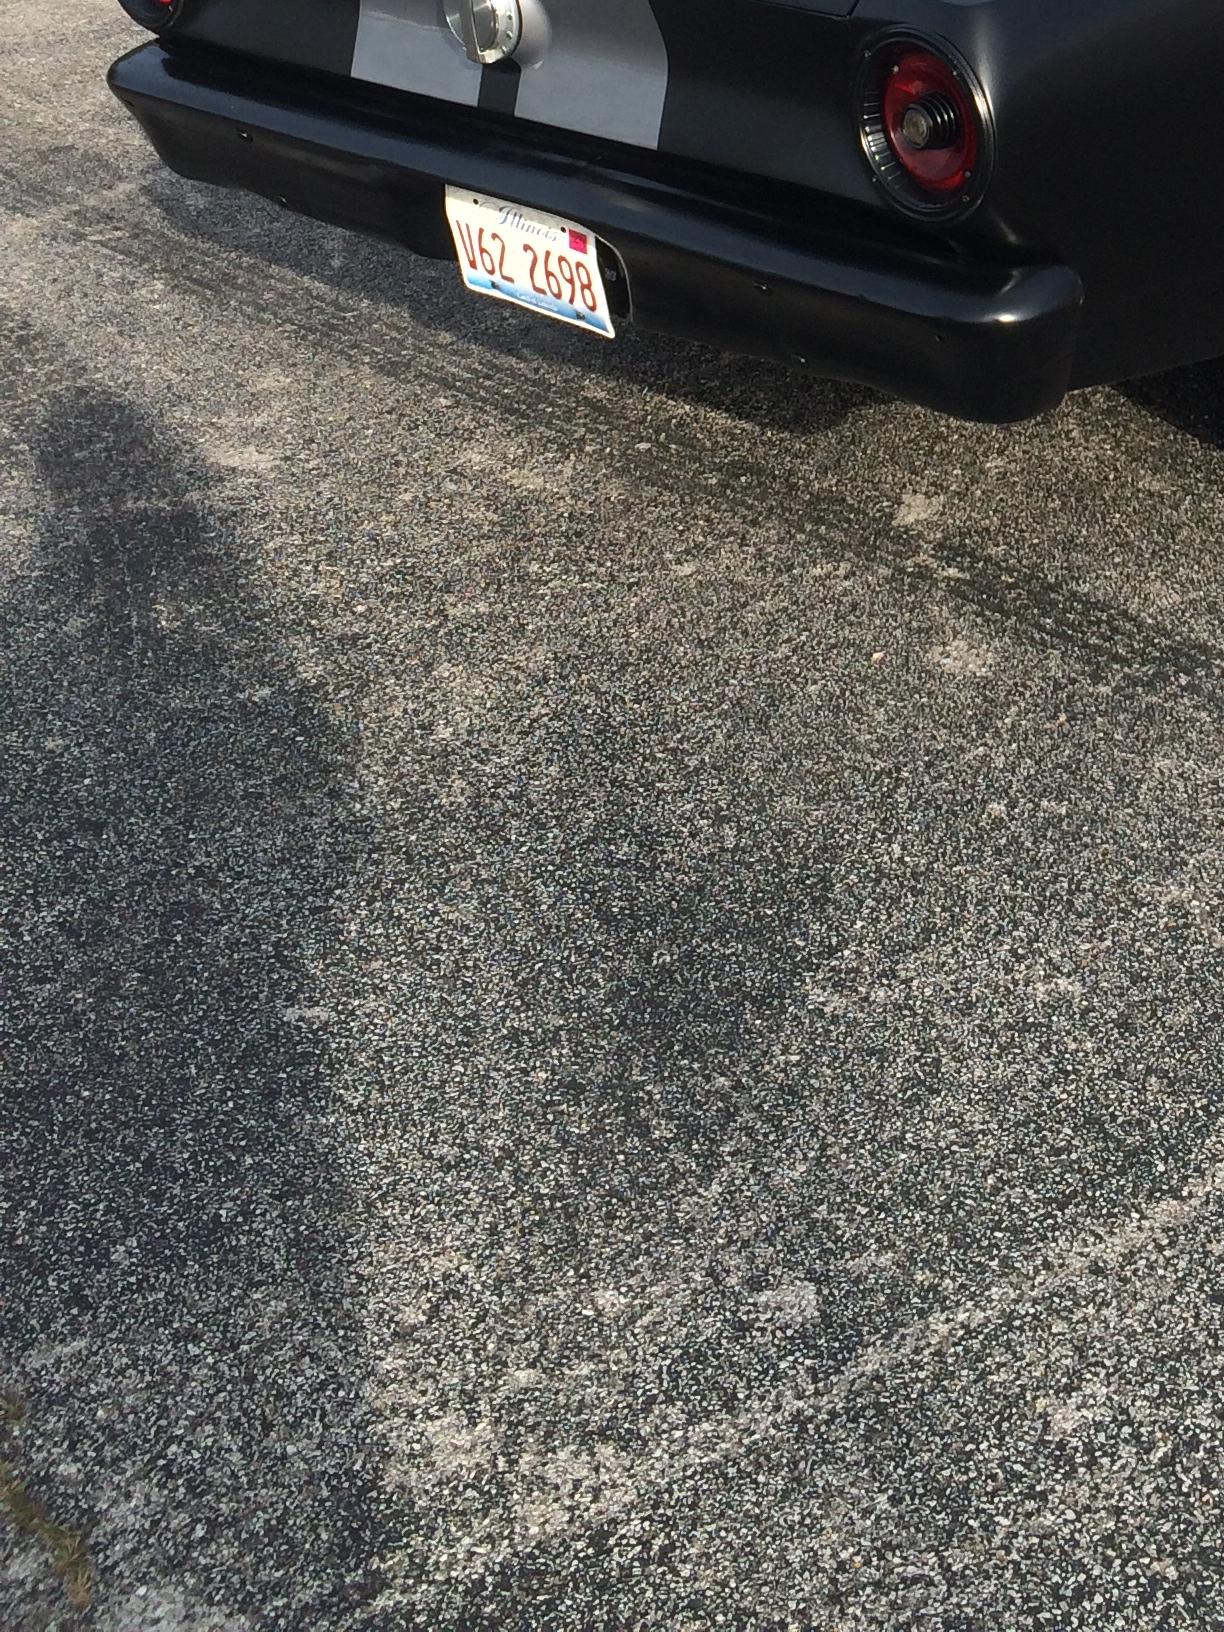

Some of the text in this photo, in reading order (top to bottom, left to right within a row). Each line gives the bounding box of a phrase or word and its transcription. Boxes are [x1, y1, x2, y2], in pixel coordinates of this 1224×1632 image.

[498, 205, 559, 241] Illinois
[456, 220, 598, 313] V62 2698
